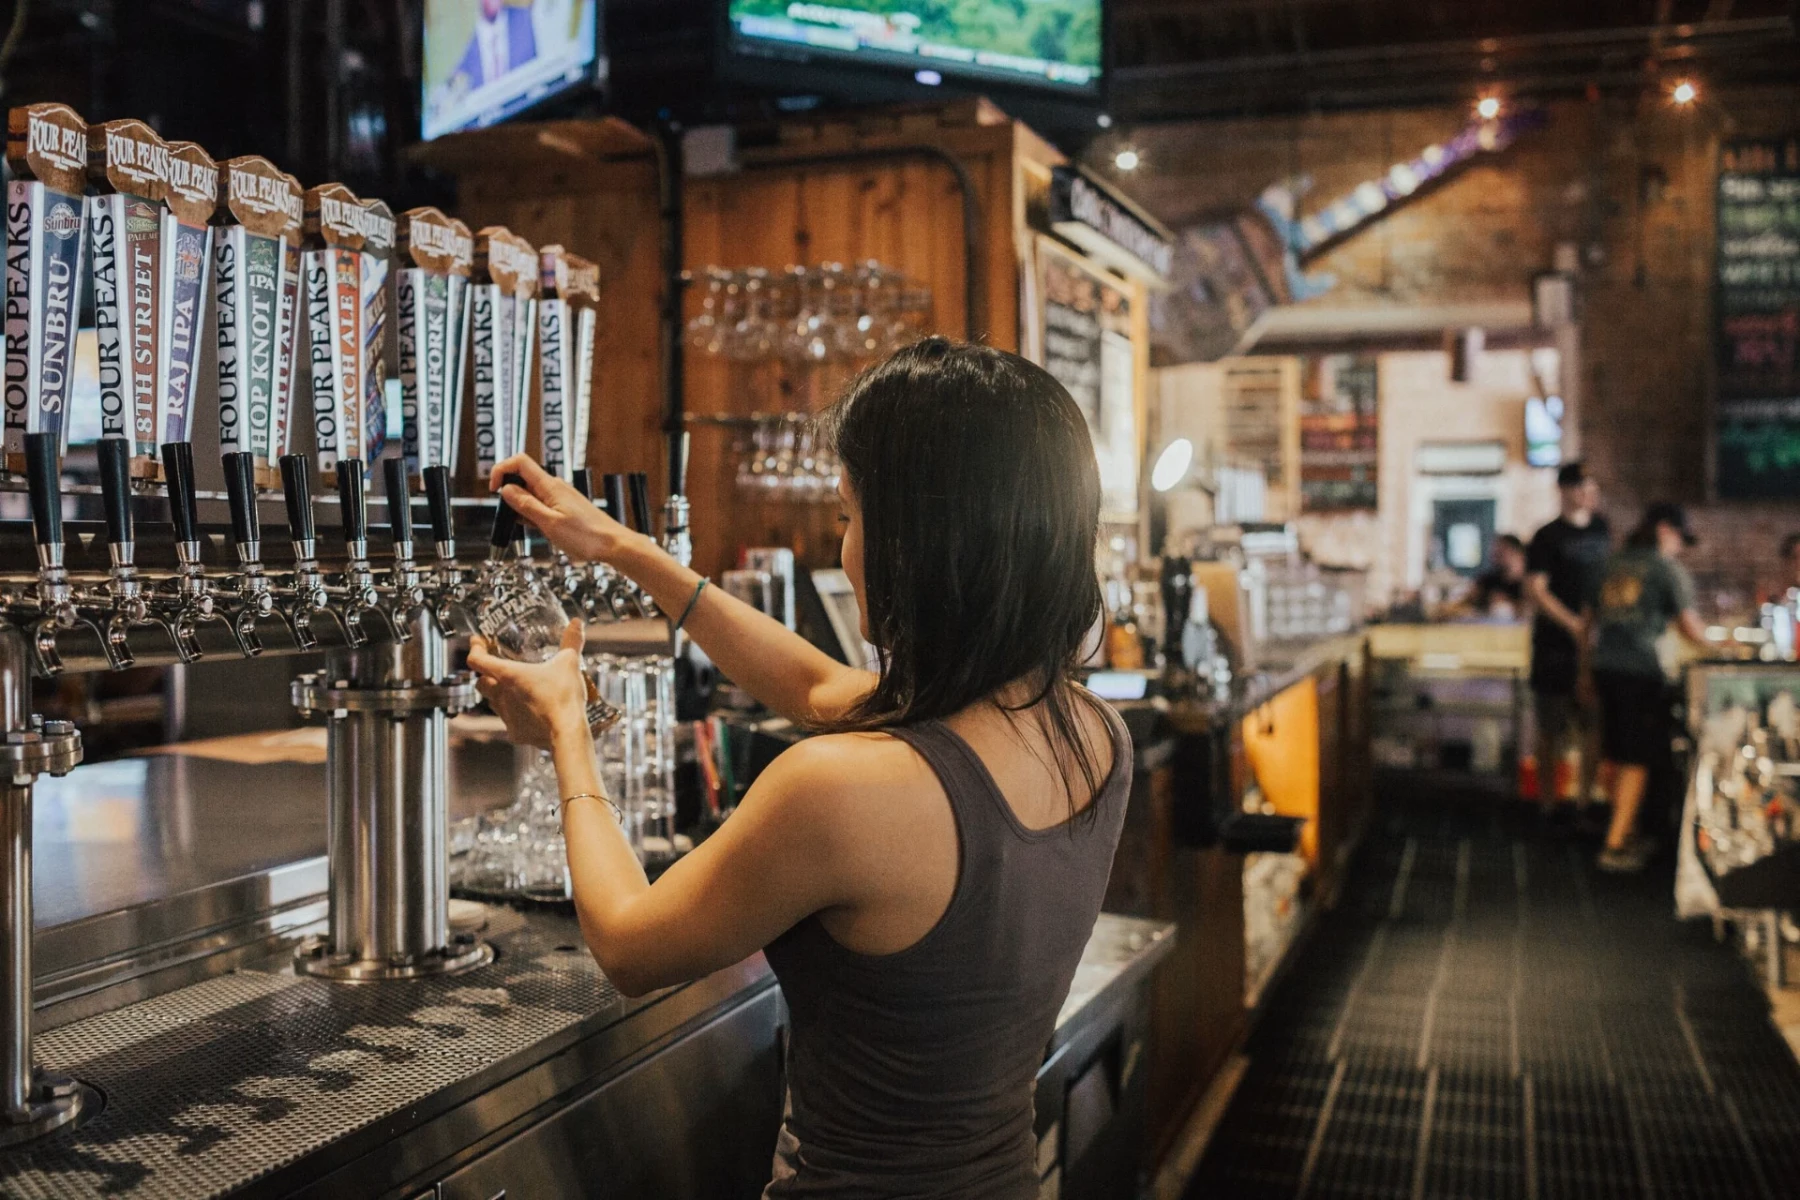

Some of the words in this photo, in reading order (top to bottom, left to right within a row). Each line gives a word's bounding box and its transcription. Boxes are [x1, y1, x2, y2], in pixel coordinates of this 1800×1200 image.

[28, 117, 60, 153] FOUR
[106, 132, 136, 168] FOUR
[136, 141, 169, 182] PEAKS
[190, 163, 219, 202] PEAKS
[229, 169, 258, 200] FOUR
[258, 176, 290, 214] PEAKS
[5, 202, 32, 323] PEAKS
[91, 215, 118, 330] PEAKS
[215, 243, 237, 349] PEAKS
[249, 274, 276, 291] IPA
[41, 256, 71, 414] SUNBRU
[135, 248, 153, 365] STREET
[172, 297, 194, 350] IPA
[250, 294, 271, 382] KNOT
[308, 266, 333, 366] PEAKS
[339, 295, 355, 347] ALE
[399, 284, 416, 374] PEAKS
[474, 300, 493, 384] PEAKS
[4, 332, 29, 430] FOUR
[99, 338, 124, 438] FOUR
[167, 359, 190, 418] RAJ
[541, 315, 562, 393] PEAKS
[135, 371, 153, 434] 8TH
[220, 357, 239, 446] FOUR
[250, 385, 270, 451] HOP
[315, 371, 337, 453] FOUR
[341, 355, 358, 447] PEACH
[402, 386, 419, 456] FOUR
[476, 392, 495, 461] FOUR
[544, 401, 564, 467] FOUR
